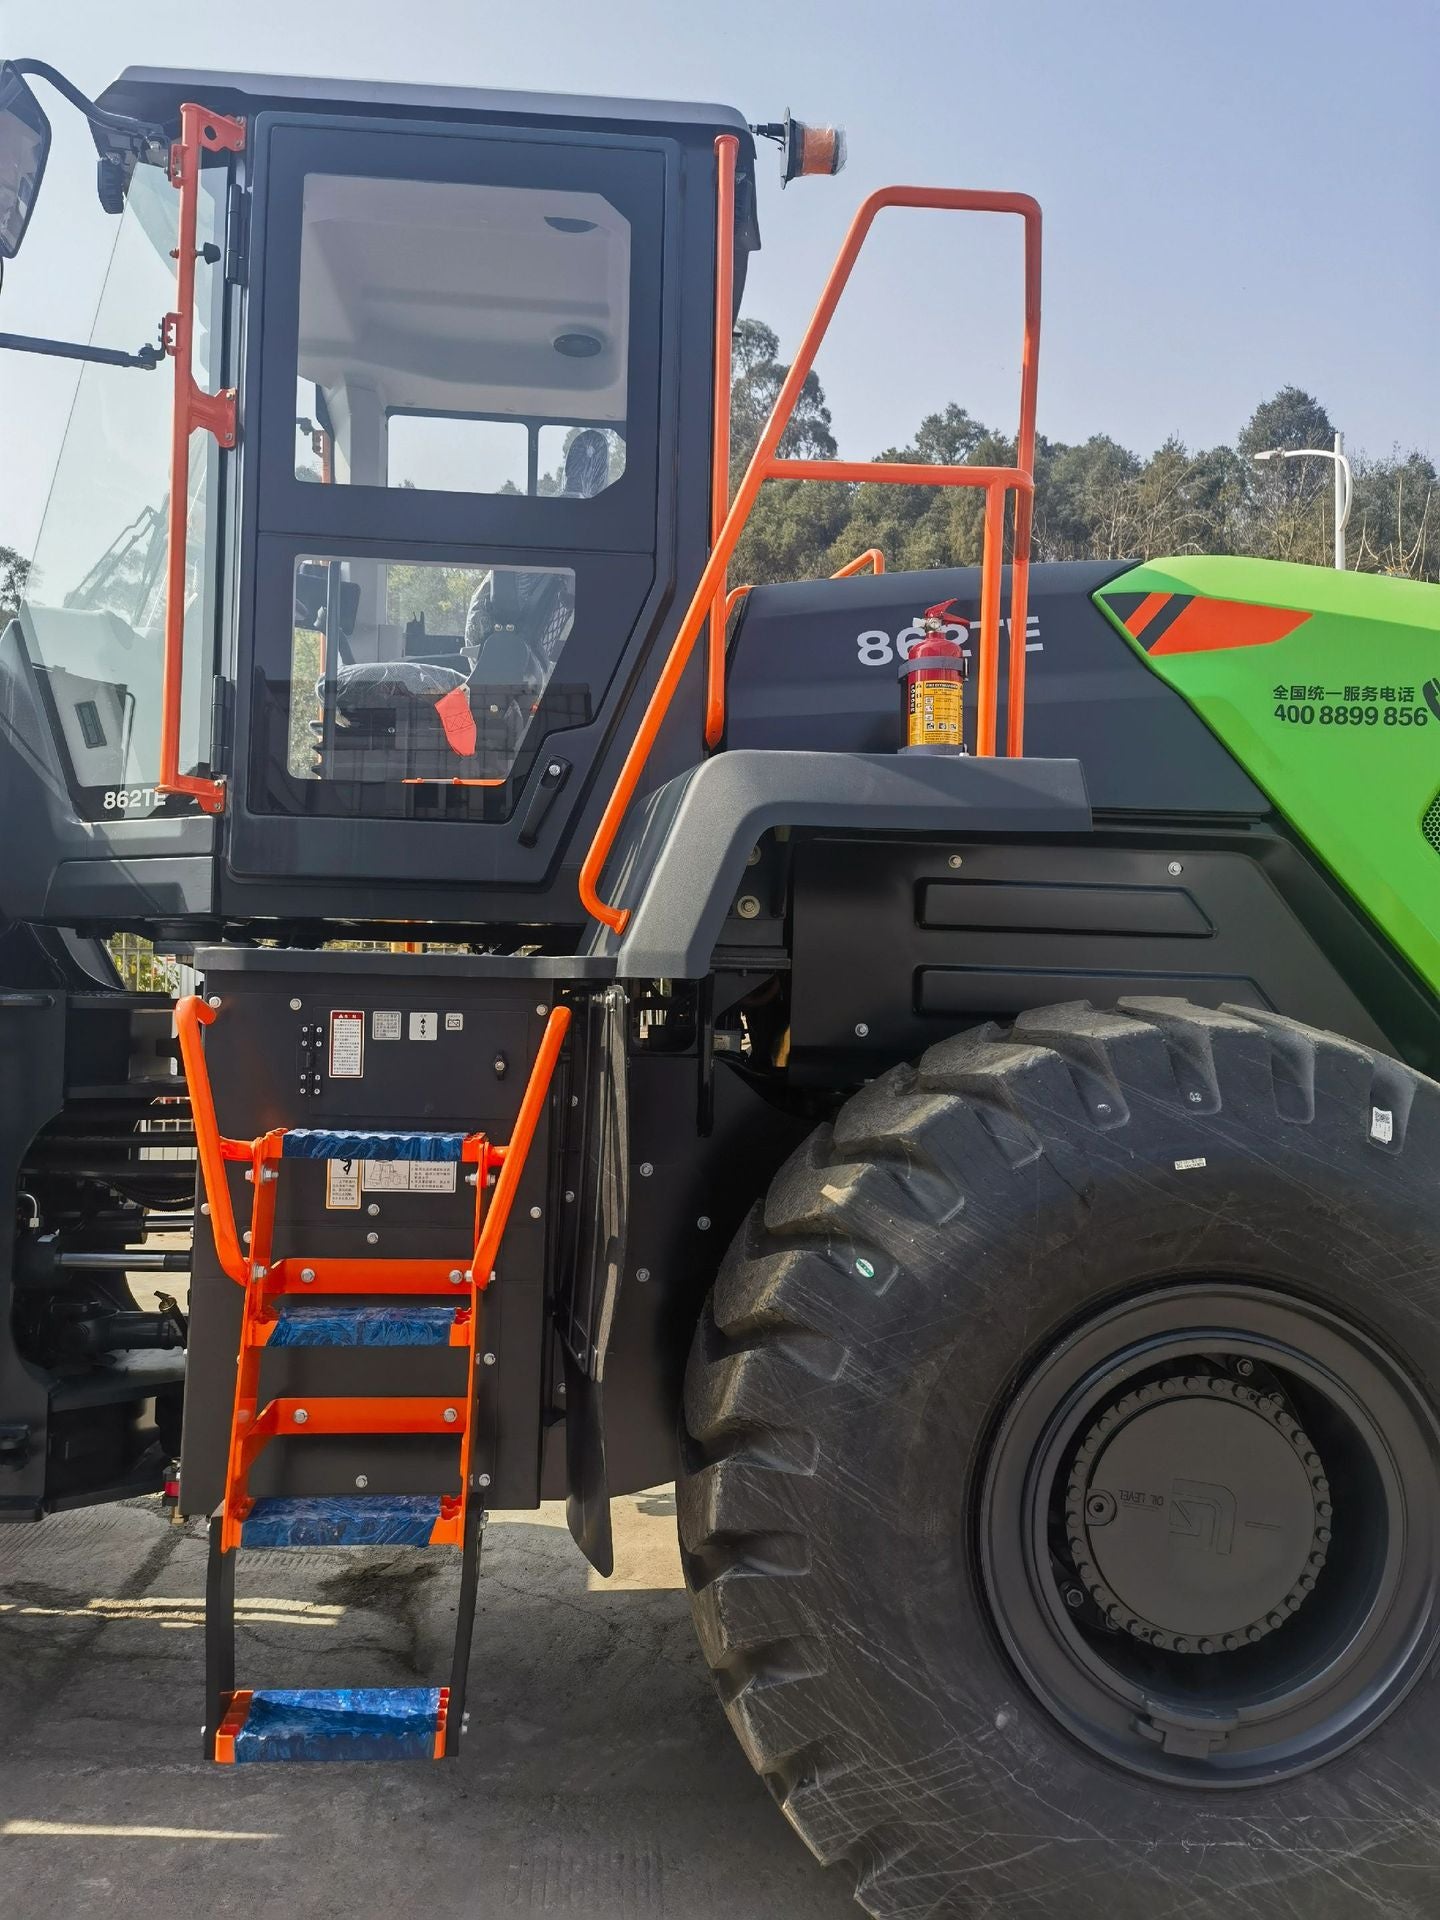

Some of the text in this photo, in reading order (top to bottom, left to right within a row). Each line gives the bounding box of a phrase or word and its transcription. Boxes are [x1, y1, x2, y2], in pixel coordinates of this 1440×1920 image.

[1272, 684, 1415, 703] 全国统一服务电话
[1274, 704, 1428, 727] 400 8899 856
[103, 788, 166, 810] 862TE
[1118, 1489, 1146, 1504] LEVEL
